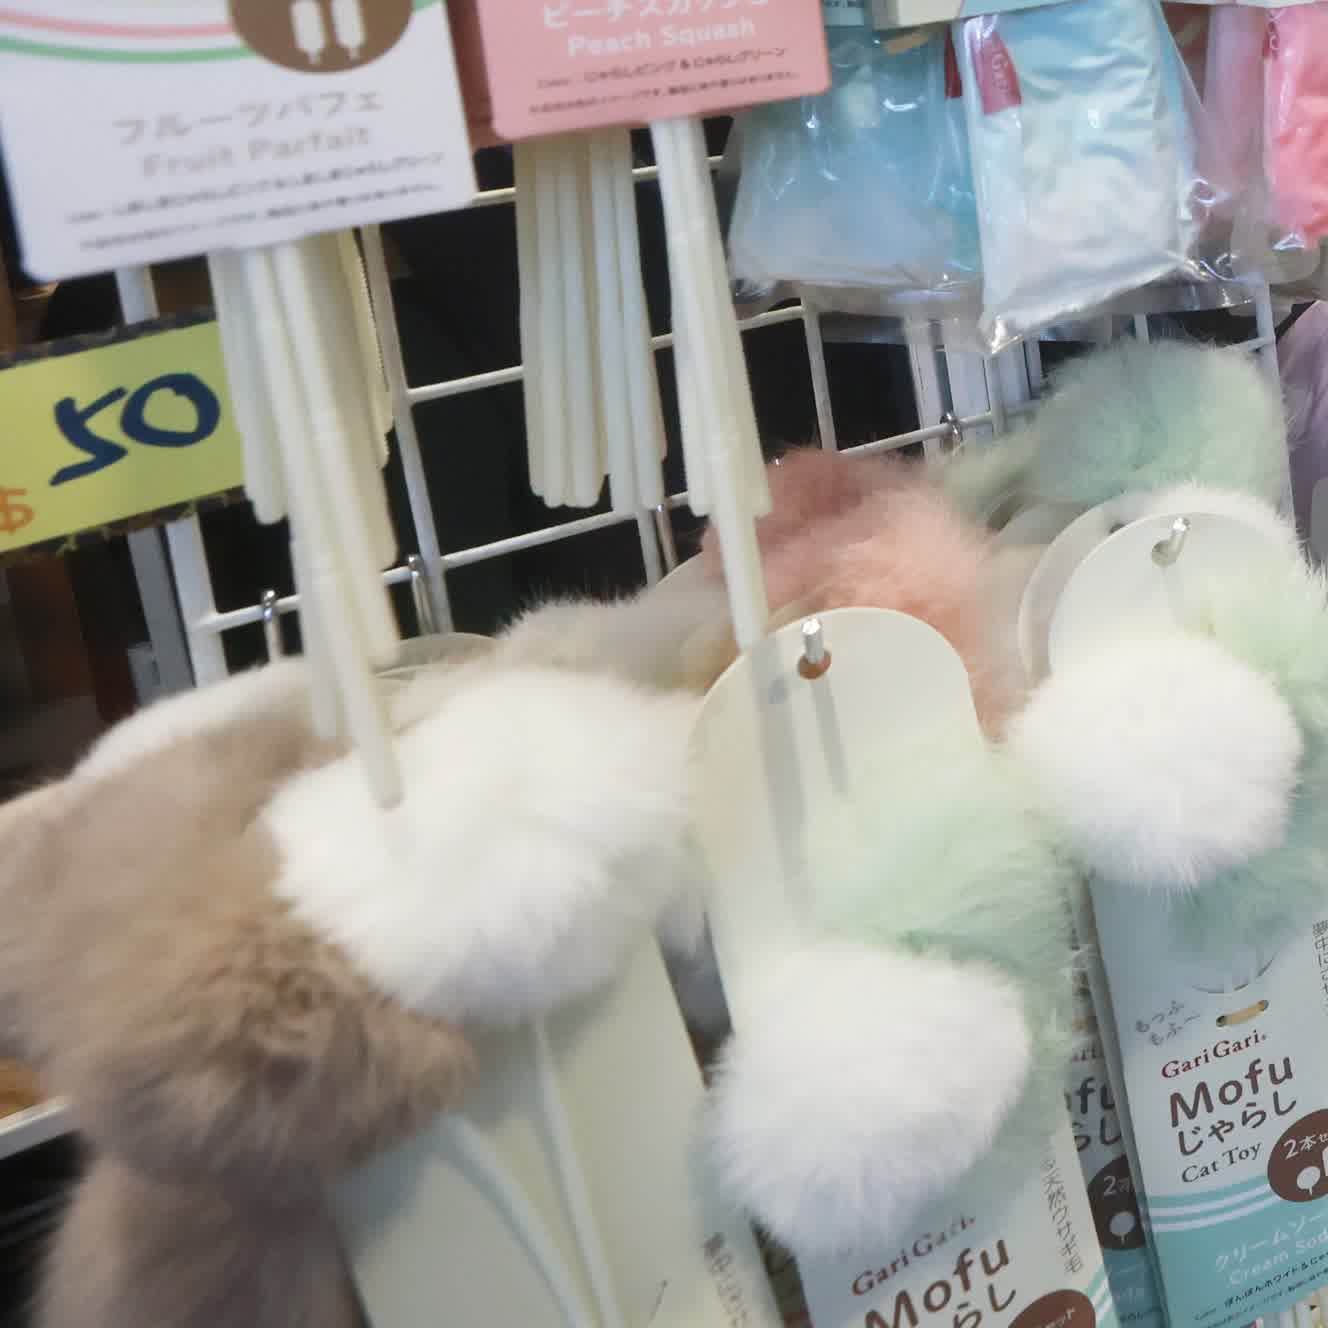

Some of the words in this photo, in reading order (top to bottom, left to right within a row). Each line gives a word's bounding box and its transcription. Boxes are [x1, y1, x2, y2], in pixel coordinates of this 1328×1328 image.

[568, 24, 651, 58] Peach
[658, 16, 757, 50] Squash
[1169, 1056, 1294, 1128] Mofu
[1177, 1090, 1297, 1157] じゃらし
[1181, 1160, 1219, 1184] Cat
[1221, 1141, 1262, 1165] Toy
[864, 1238, 1011, 1328] Mofu
